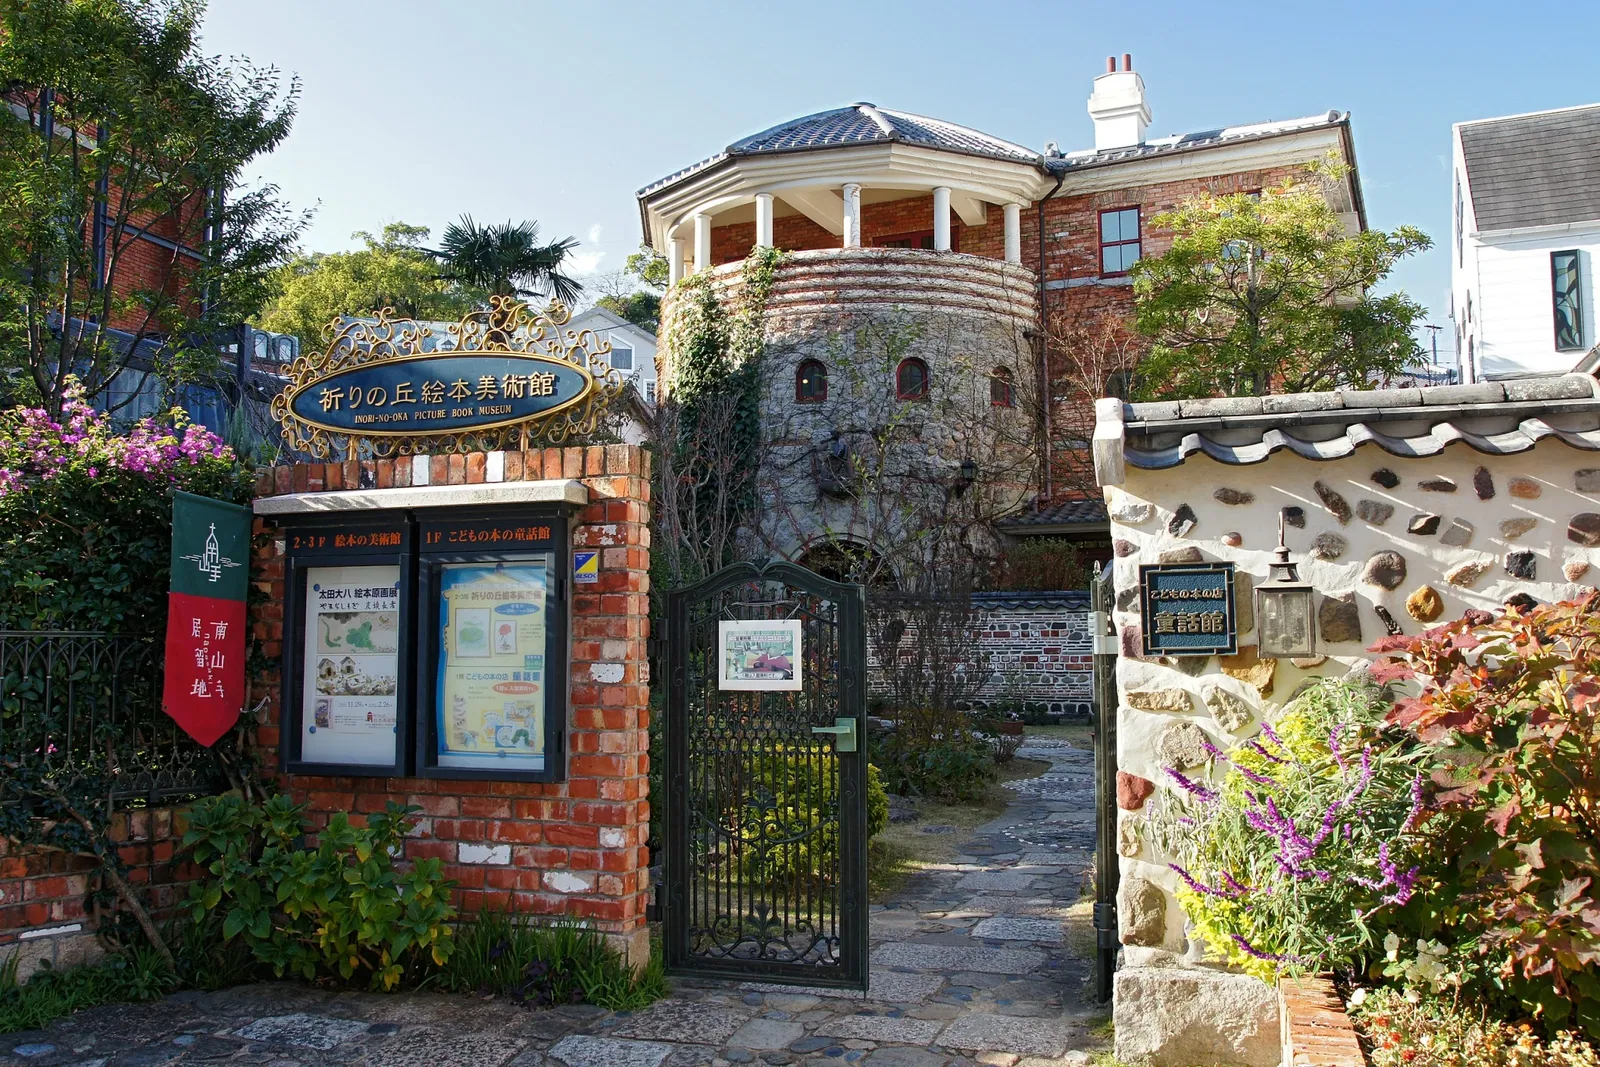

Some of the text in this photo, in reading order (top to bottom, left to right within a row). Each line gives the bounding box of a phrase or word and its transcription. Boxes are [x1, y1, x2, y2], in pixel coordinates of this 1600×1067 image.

[319, 371, 556, 412] 祈りの丘絵本美術館
[354, 404, 512, 424] INORI-NO-OKA PICTURE BOOK MUSEUM
[334, 532, 401, 547] 絵本の美術館
[426, 526, 550, 544] 1F こどもの本の童話館
[319, 587, 398, 600] 太田大八 絵本原画展
[1150, 586, 1224, 600] こどもの本の店
[1153, 608, 1225, 634] 童話館
[190, 617, 212, 698] 居留地
[209, 620, 229, 699] 南山手
